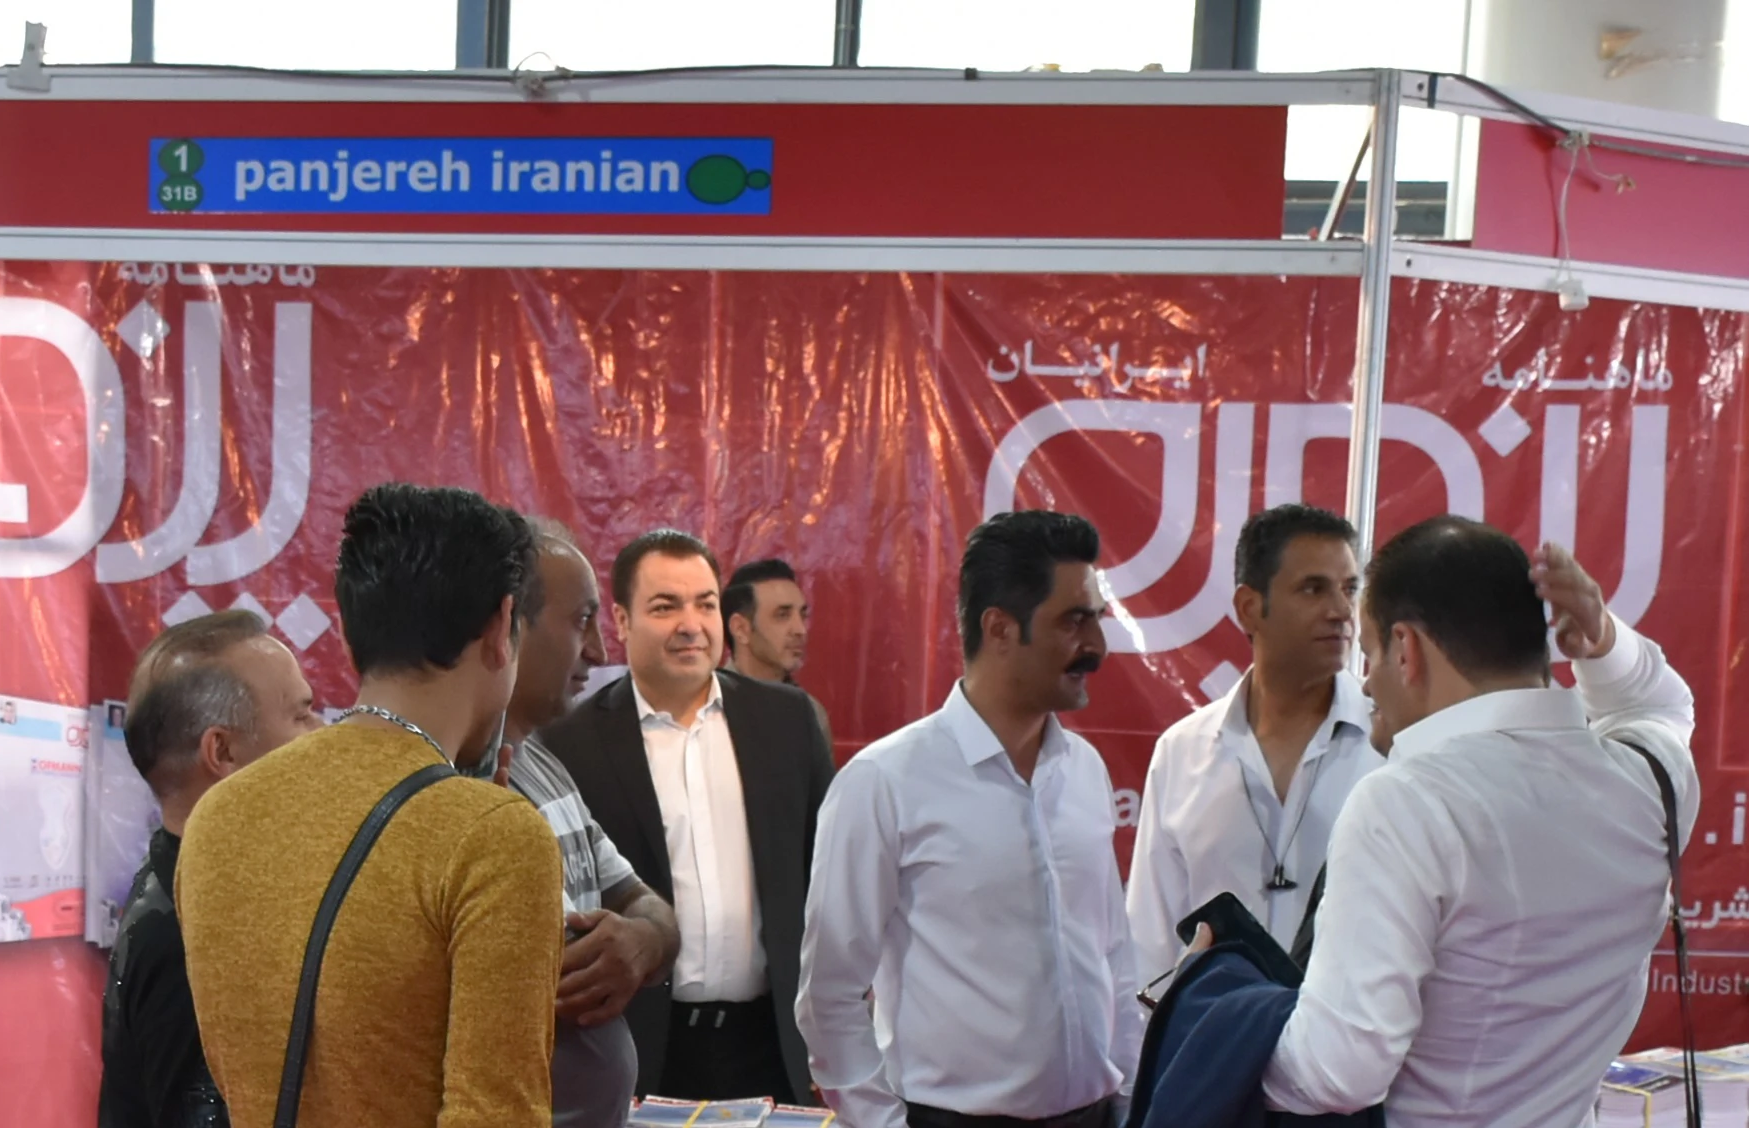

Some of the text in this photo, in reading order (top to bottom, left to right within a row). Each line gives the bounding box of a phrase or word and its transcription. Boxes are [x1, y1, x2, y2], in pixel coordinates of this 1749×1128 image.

[174, 144, 188, 173] 1
[235, 149, 680, 202] panjereh iranian
[161, 185, 198, 202] 31B
[987, 339, 1674, 394] ماهنامه ایرانیان
